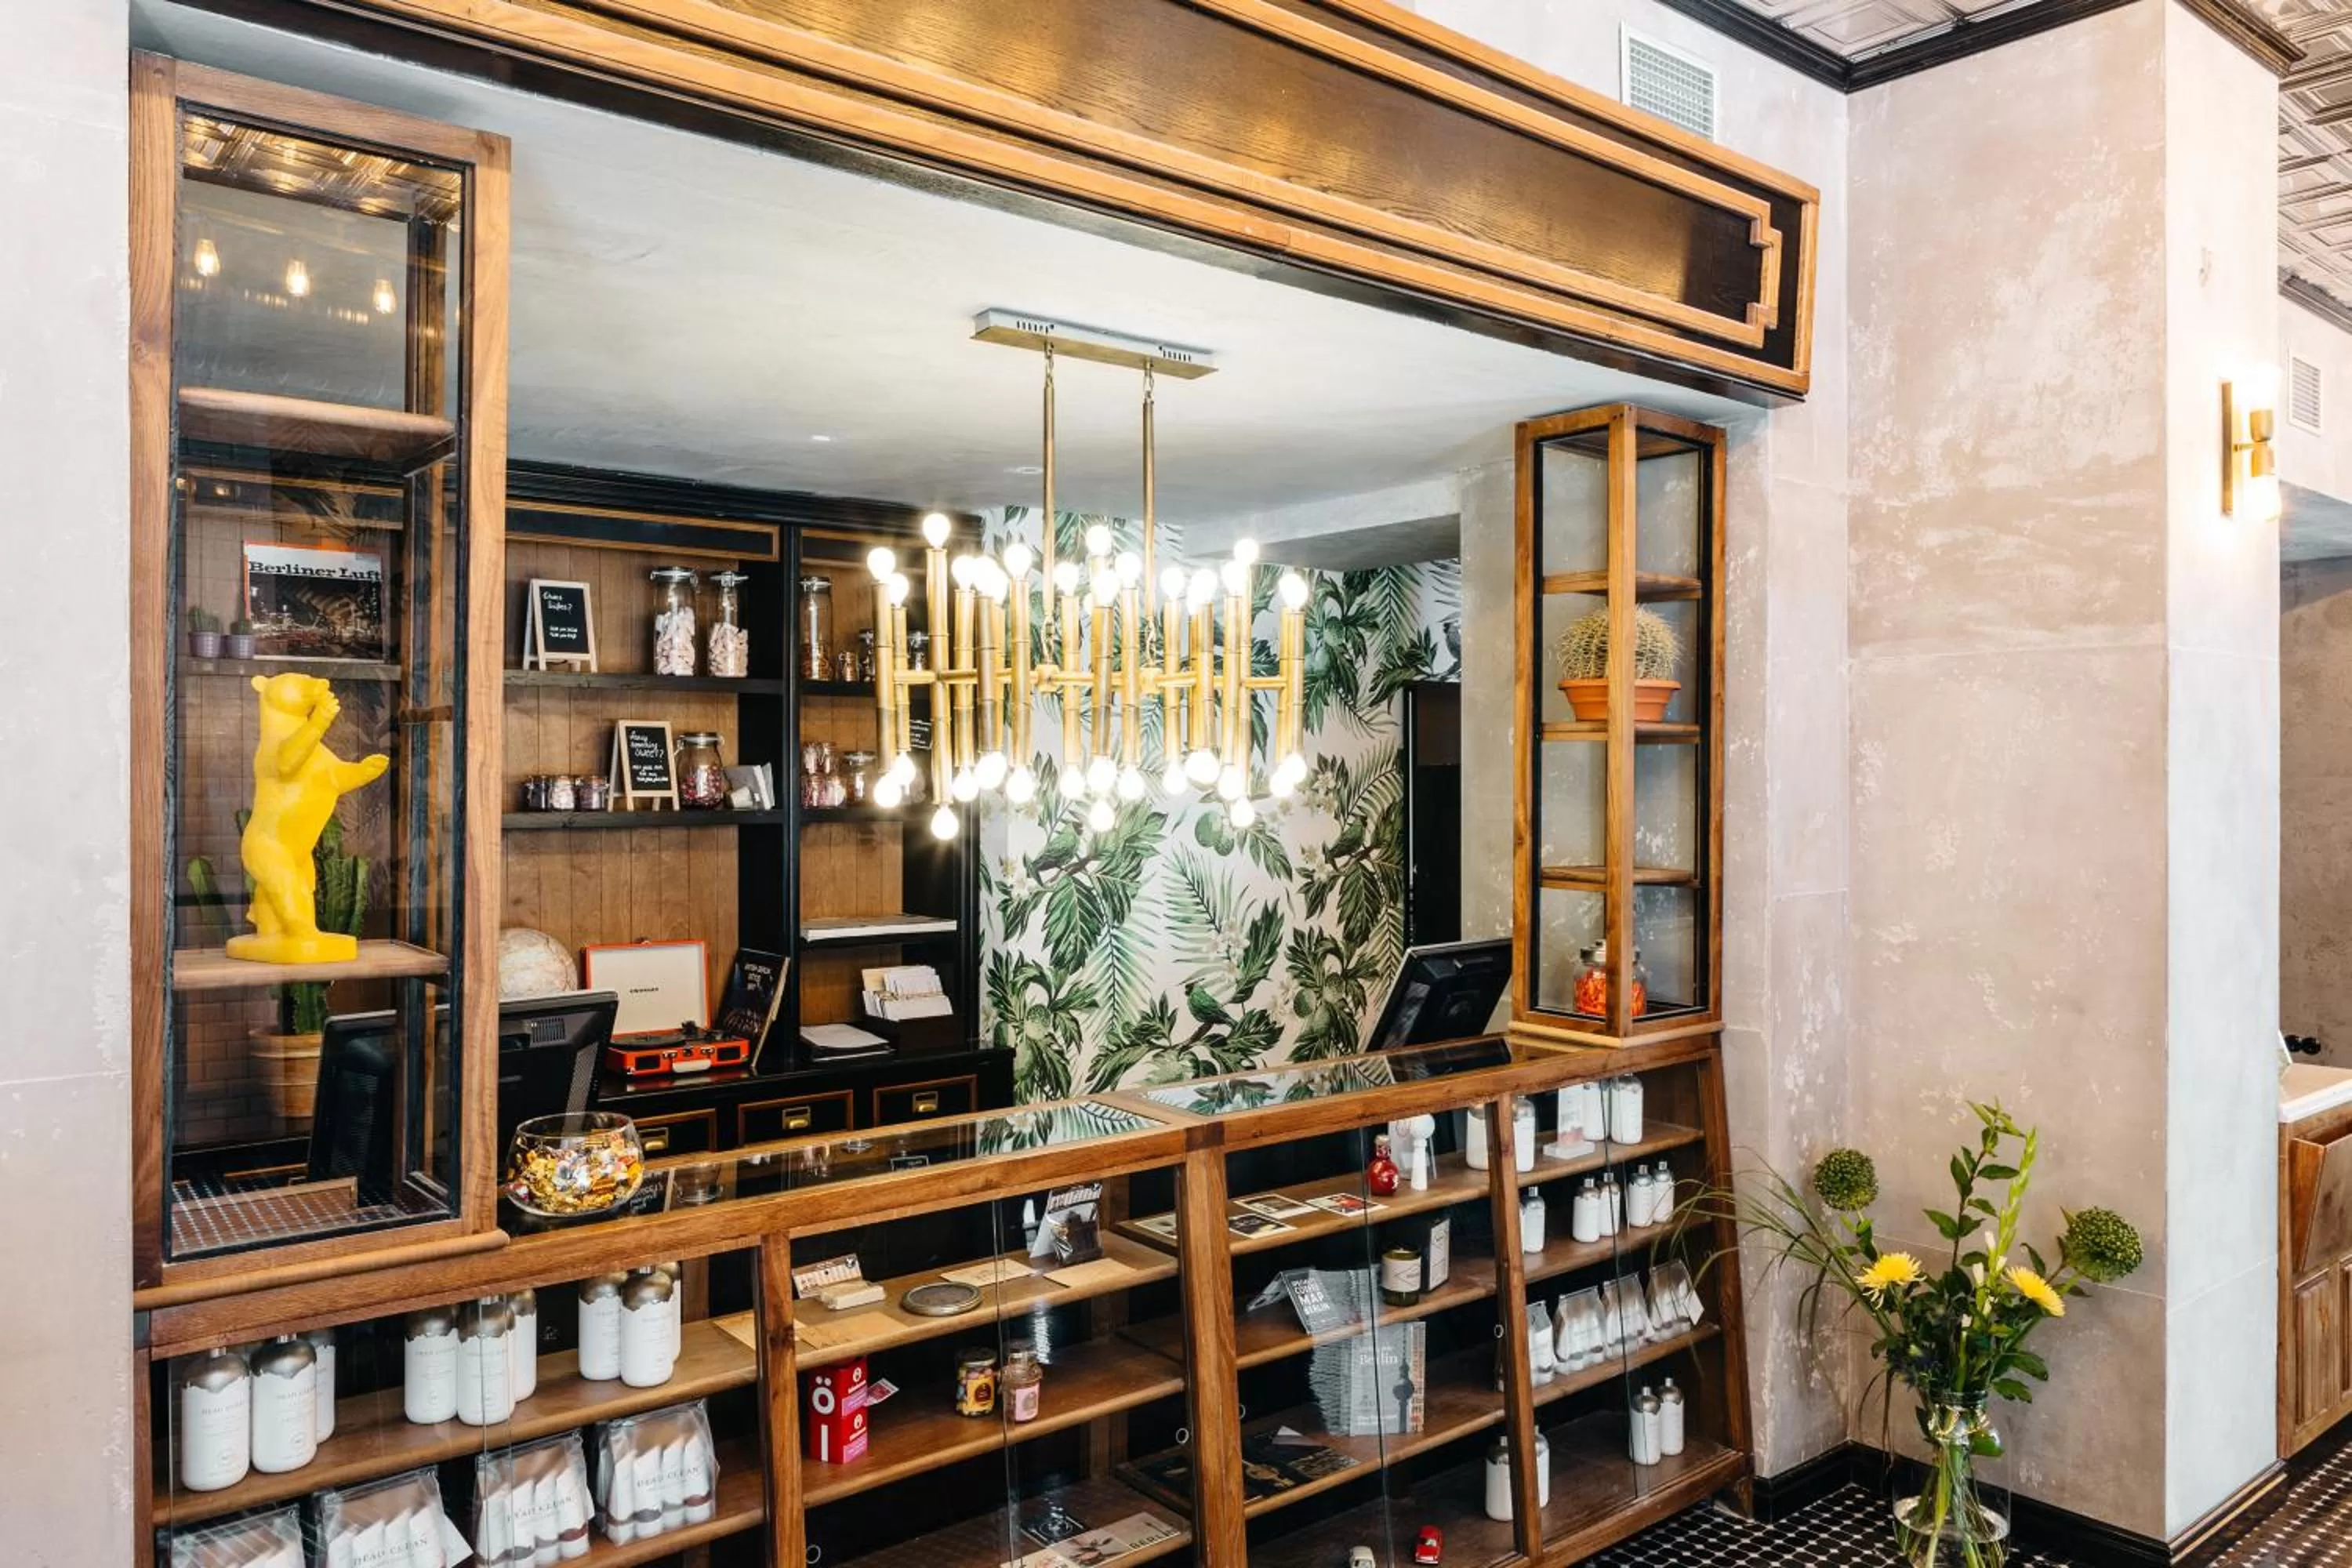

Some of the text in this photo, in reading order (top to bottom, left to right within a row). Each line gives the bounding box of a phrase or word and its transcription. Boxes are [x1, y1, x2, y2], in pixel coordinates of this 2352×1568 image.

[249, 561, 382, 583] Berliner Luft
[1298, 1291, 1324, 1305] MAP
[1359, 1352, 1399, 1365] Berlin
